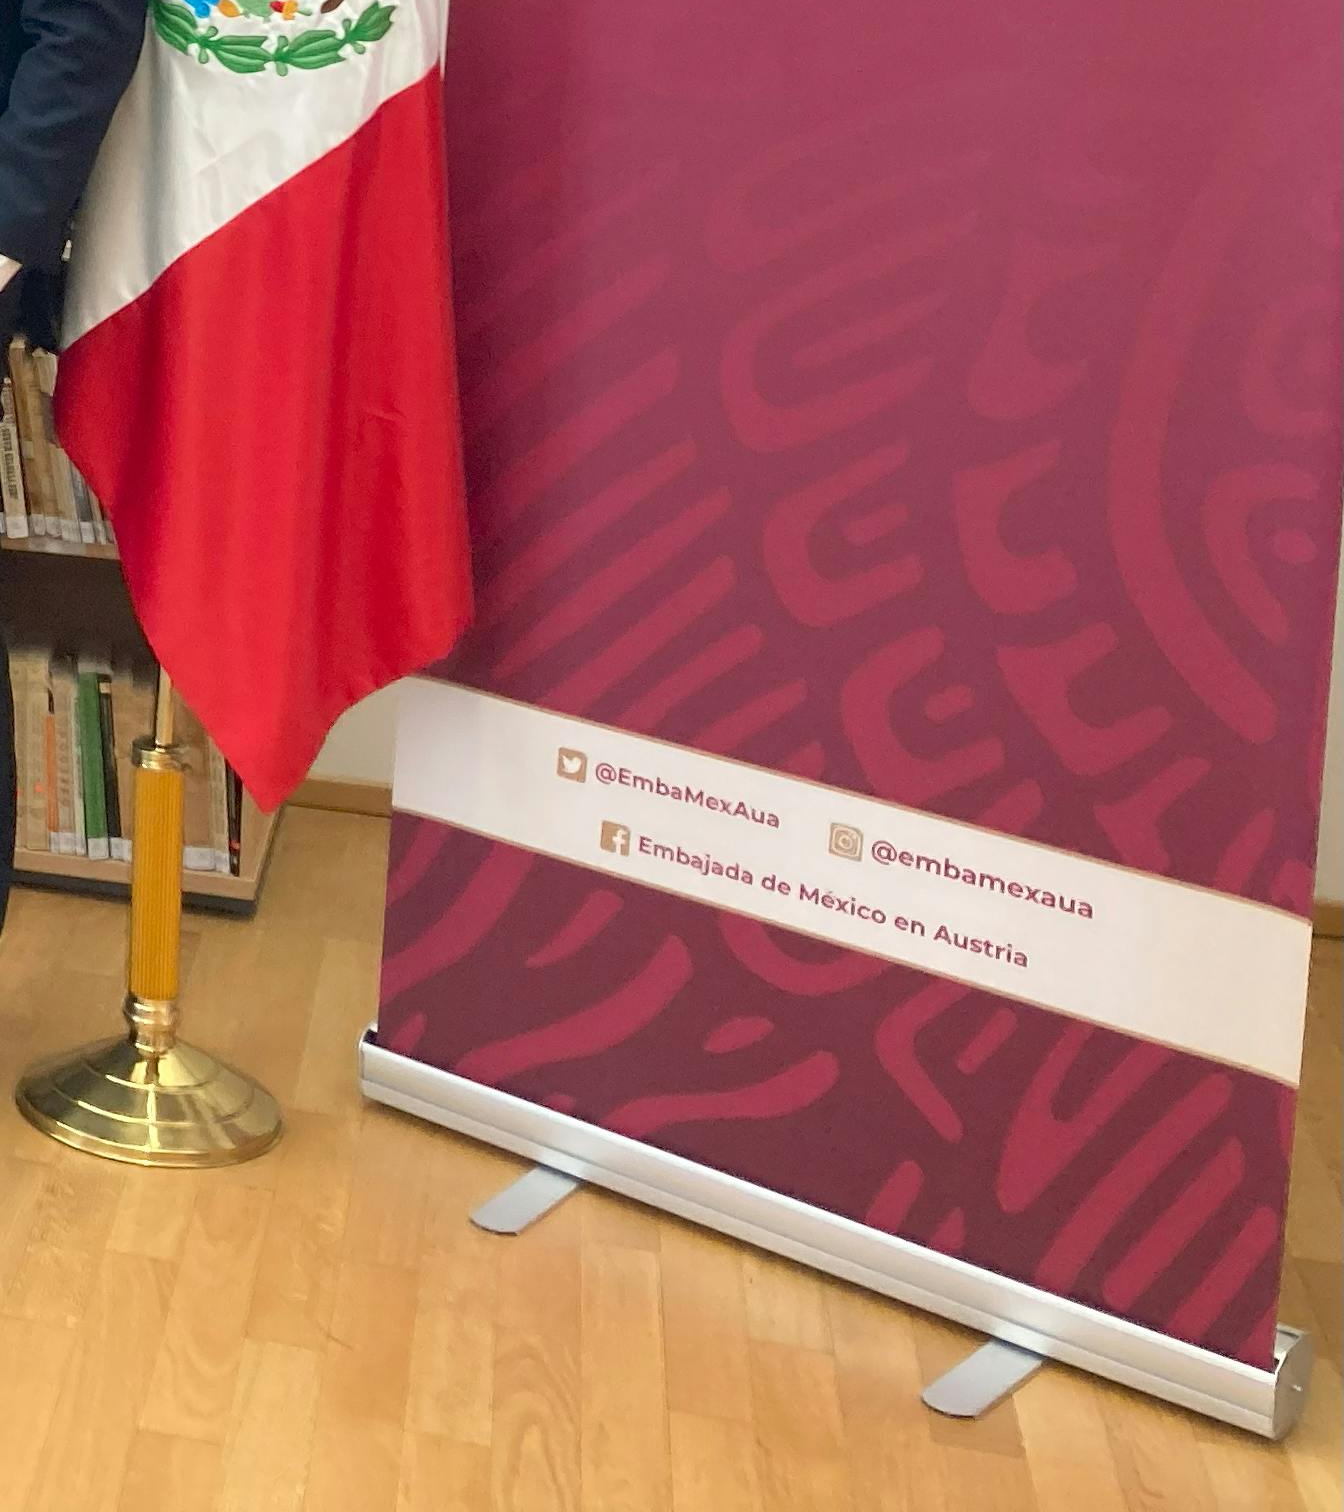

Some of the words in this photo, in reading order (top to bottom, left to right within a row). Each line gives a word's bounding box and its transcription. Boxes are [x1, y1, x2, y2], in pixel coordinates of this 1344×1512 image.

[595, 761, 781, 830] @EmbaMexAua
[639, 835, 753, 886] Embajada
[761, 874, 791, 897] de
[799, 883, 887, 926] México
[894, 914, 926, 937] en
[934, 924, 1030, 969] Austria
[870, 839, 1095, 920] @embamexaua
